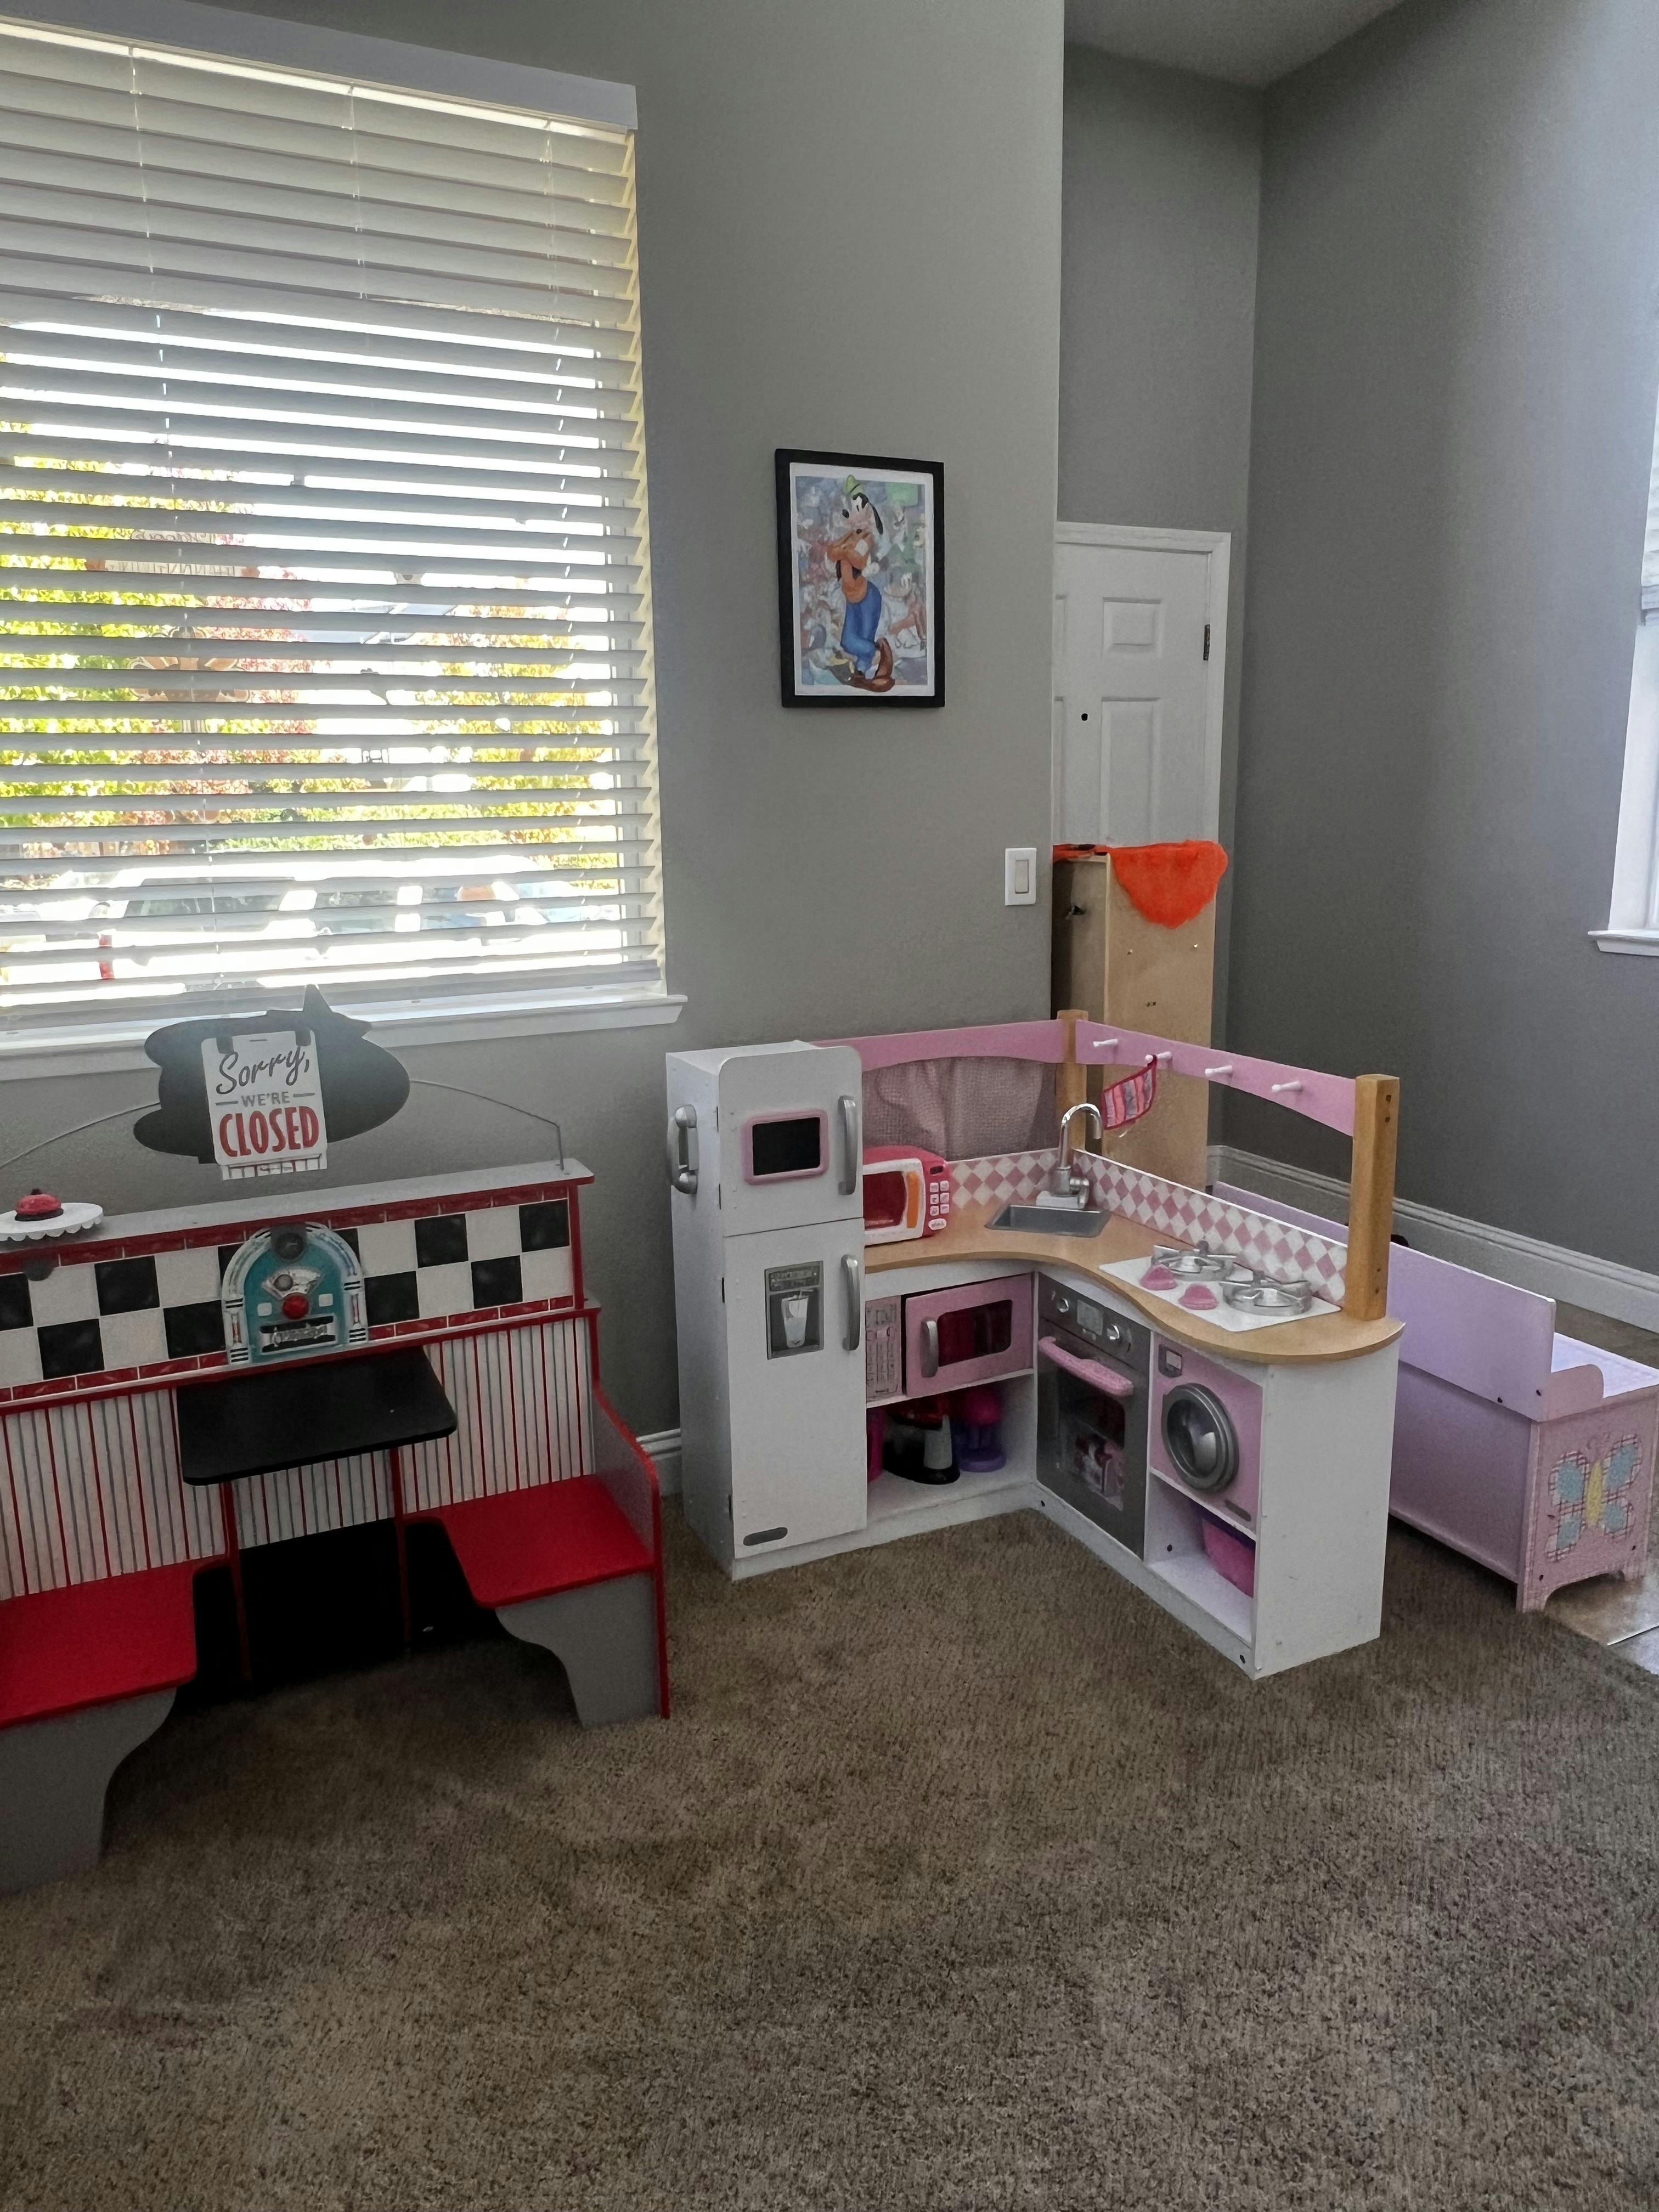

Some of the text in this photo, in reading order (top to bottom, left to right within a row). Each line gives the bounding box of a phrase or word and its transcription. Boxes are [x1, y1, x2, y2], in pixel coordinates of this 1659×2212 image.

[216, 1045, 310, 1094] Sorry,
[240, 1091, 291, 1108] WE'RE
[219, 1105, 319, 1158] CLOSED
